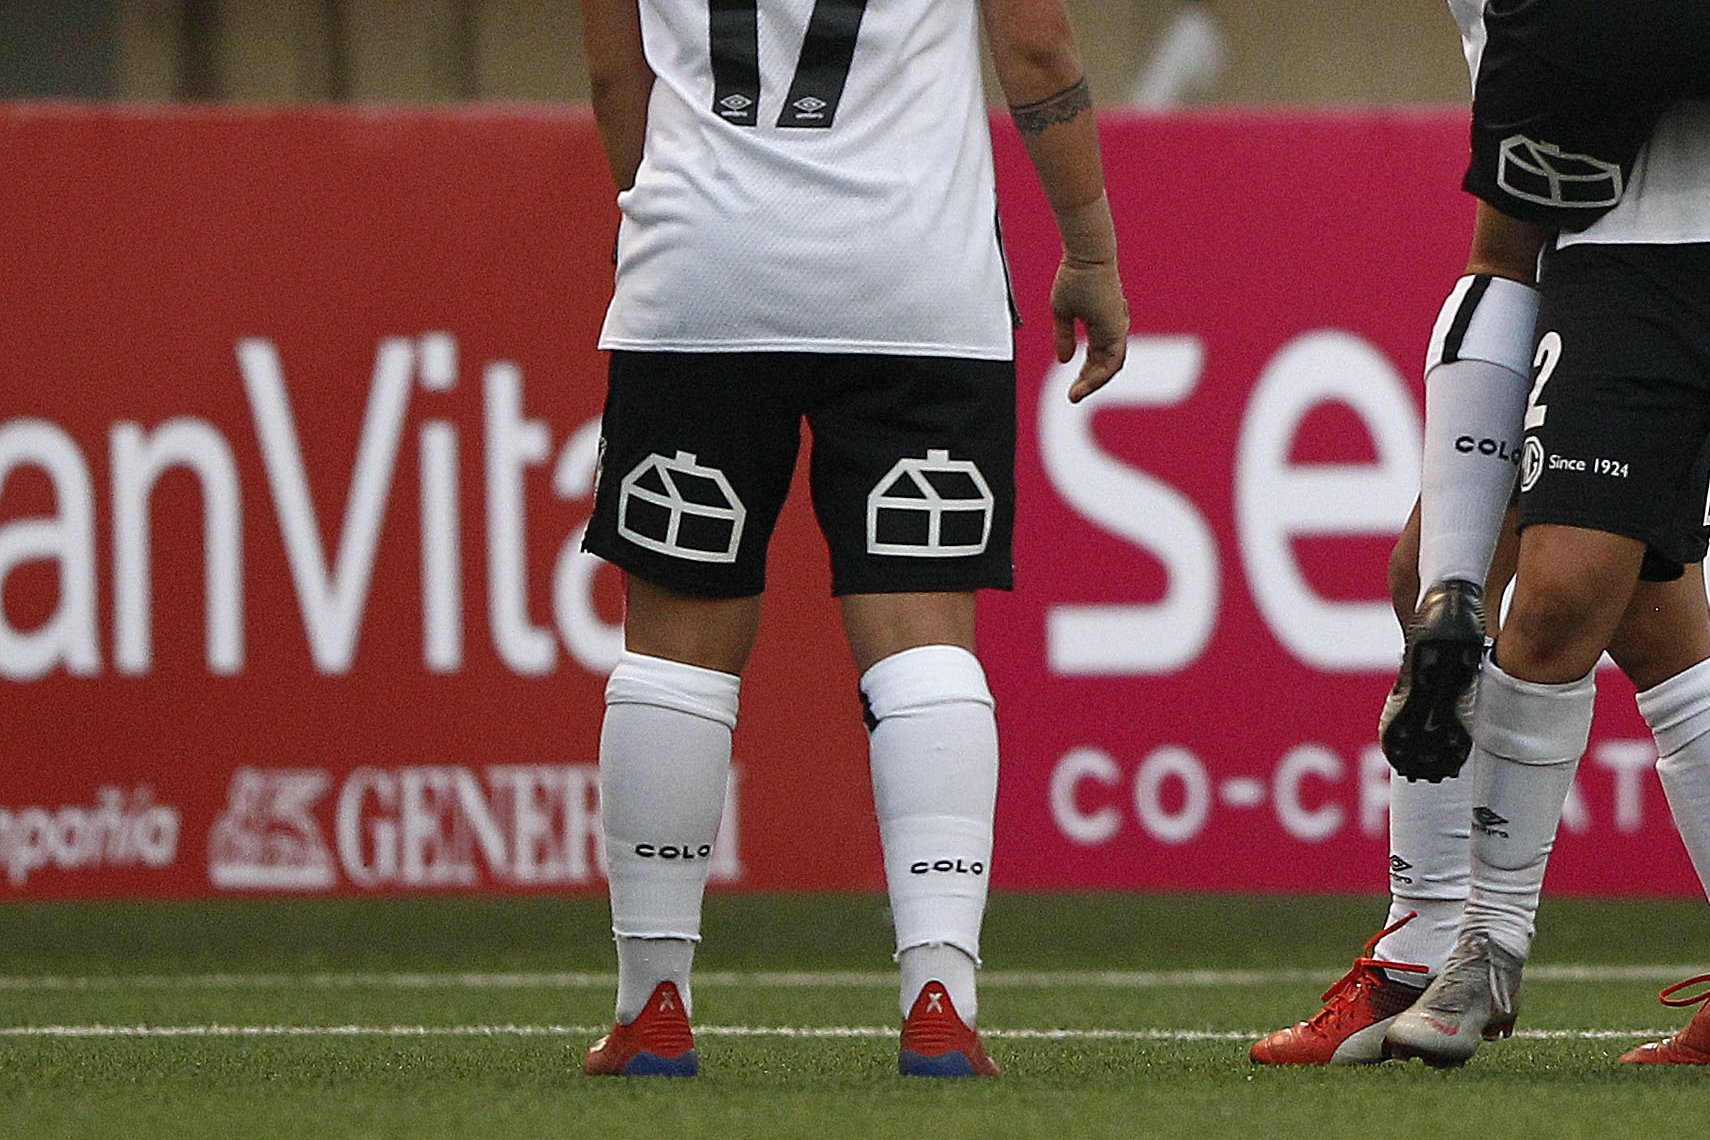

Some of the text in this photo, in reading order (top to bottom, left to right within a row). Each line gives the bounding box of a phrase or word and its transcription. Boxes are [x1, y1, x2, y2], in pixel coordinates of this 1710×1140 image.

[1548, 454, 1630, 478] Since 1924
[635, 843, 711, 859] COLO
[910, 859, 984, 876] COLO
